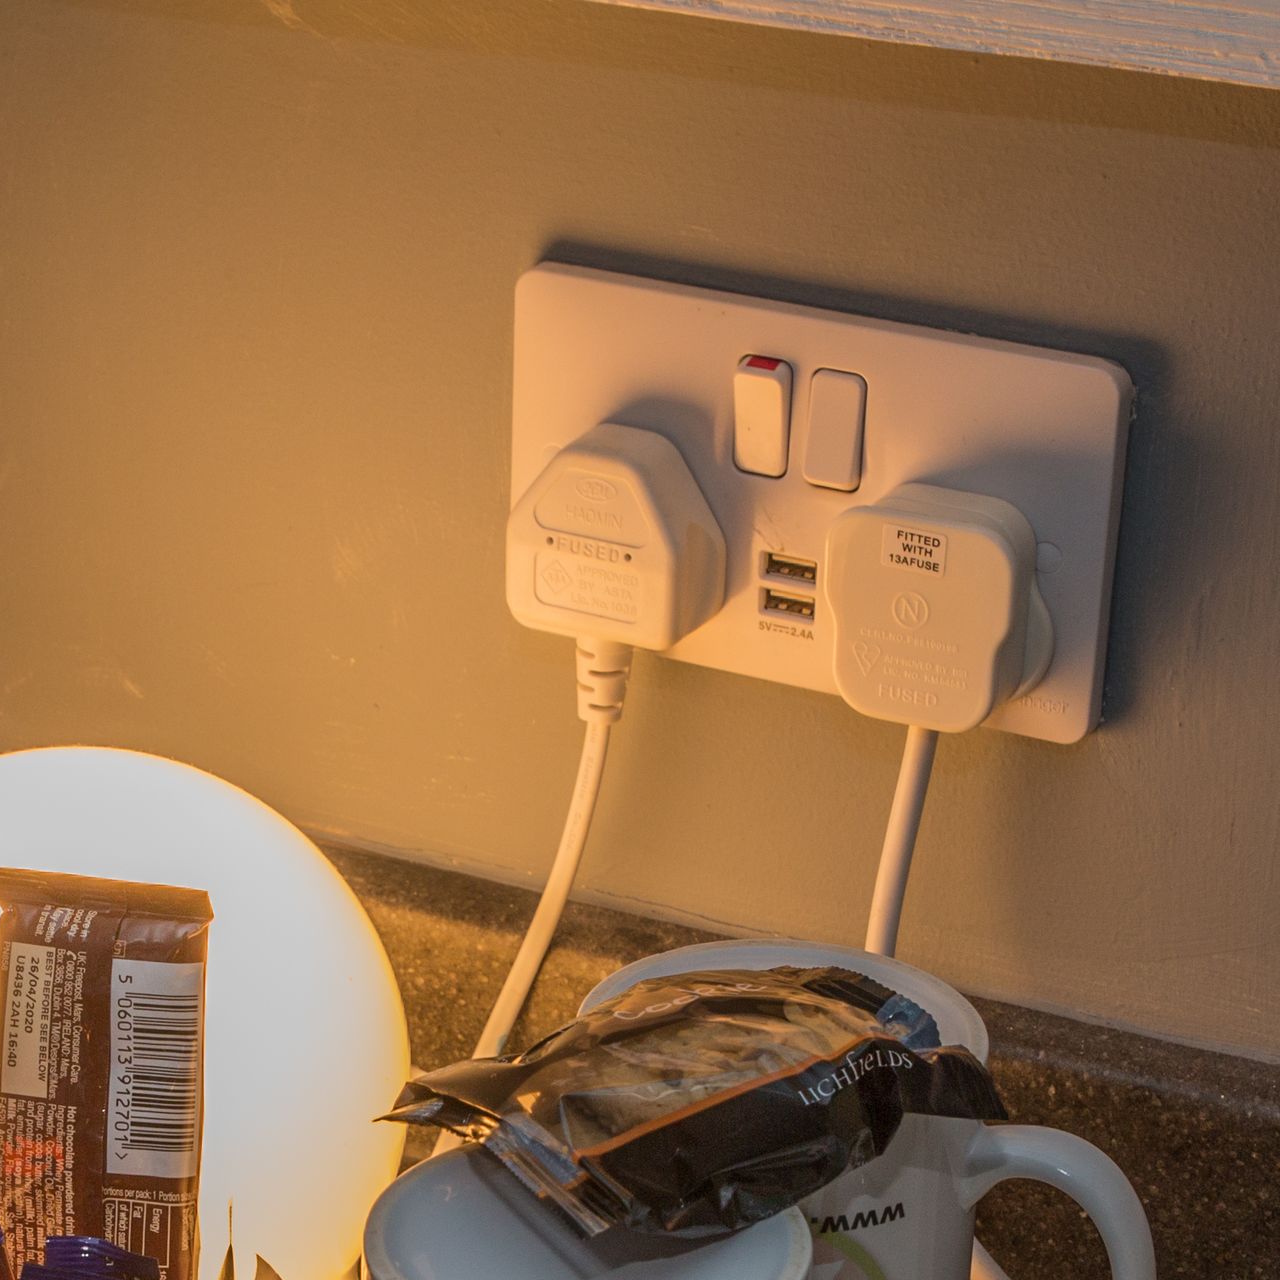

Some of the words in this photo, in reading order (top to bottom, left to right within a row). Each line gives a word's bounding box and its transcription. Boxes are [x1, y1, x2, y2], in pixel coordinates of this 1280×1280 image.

[556, 536, 620, 563] FUSED
[897, 529, 941, 548] FITTED
[902, 542, 933, 558] WITH
[889, 553, 940, 573] 13AFUSE
[759, 620, 772, 632] 5V
[878, 683, 937, 708] FUSED
[44, 951, 53, 977] BEST
[55, 948, 65, 963] Box
[76, 950, 86, 966] UK:
[12, 954, 25, 997] U8436
[117, 974, 132, 984] 5
[23, 956, 39, 1034] 26/04/2020
[40, 980, 51, 1020] BEFORE
[52, 987, 63, 1011] Dublin
[9, 1000, 22, 1028] 2AH
[72, 1003, 83, 1023] Mars,
[38, 1023, 48, 1043] SEE
[60, 1018, 72, 1056] IRELAND:
[71, 1025, 83, 1063] Consumer
[113, 997, 135, 1066] 060113
[6, 1031, 18, 1068] 16:40
[36, 1045, 47, 1083] BELOW
[59, 1057, 69, 1079] Mars,
[69, 1064, 80, 1085] Care.
[7, 1097, 15, 1119] Milk
[16, 1099, 24, 1111] fat,
[26, 1100, 34, 1117] and
[34, 1102, 44, 1131] (sugar,
[66, 1106, 76, 1123] Hot
[112, 1075, 131, 1144] 912701
[45, 1103, 55, 1137] Powder,
[54, 1105, 66, 1156] Ingredients:
[4, 1122, 13, 1155] Powder,
[15, 1114, 24, 1154] emulsifier
[23, 1118, 34, 1149] protein
[34, 1133, 43, 1159] cocoa
[64, 1124, 76, 1168] chocolate
[12, 1157, 23, 1184] (soya
[24, 1150, 33, 1170] from
[44, 1140, 54, 1175] Coconut
[53, 1158, 63, 1182] Whey
[1, 1158, 13, 1210] Flavourings,
[22, 1172, 33, 1193] whey
[33, 1160, 43, 1186] butter,
[62, 1170, 75, 1212] powdered
[23, 1195, 34, 1224] (milk),
[34, 1189, 45, 1225] skimmed
[44, 1193, 54, 1216] Dried
[119, 1203, 128, 1211] of
[132, 1205, 143, 1218] Fat
[4, 1211, 13, 1229] Salt,
[118, 1211, 128, 1230] which
[149, 1207, 162, 1233] Energy
[14, 1223, 23, 1251] natural
[23, 1227, 33, 1246] palm
[36, 1227, 44, 1248] milk
[25, 1249, 34, 1261] fat,
